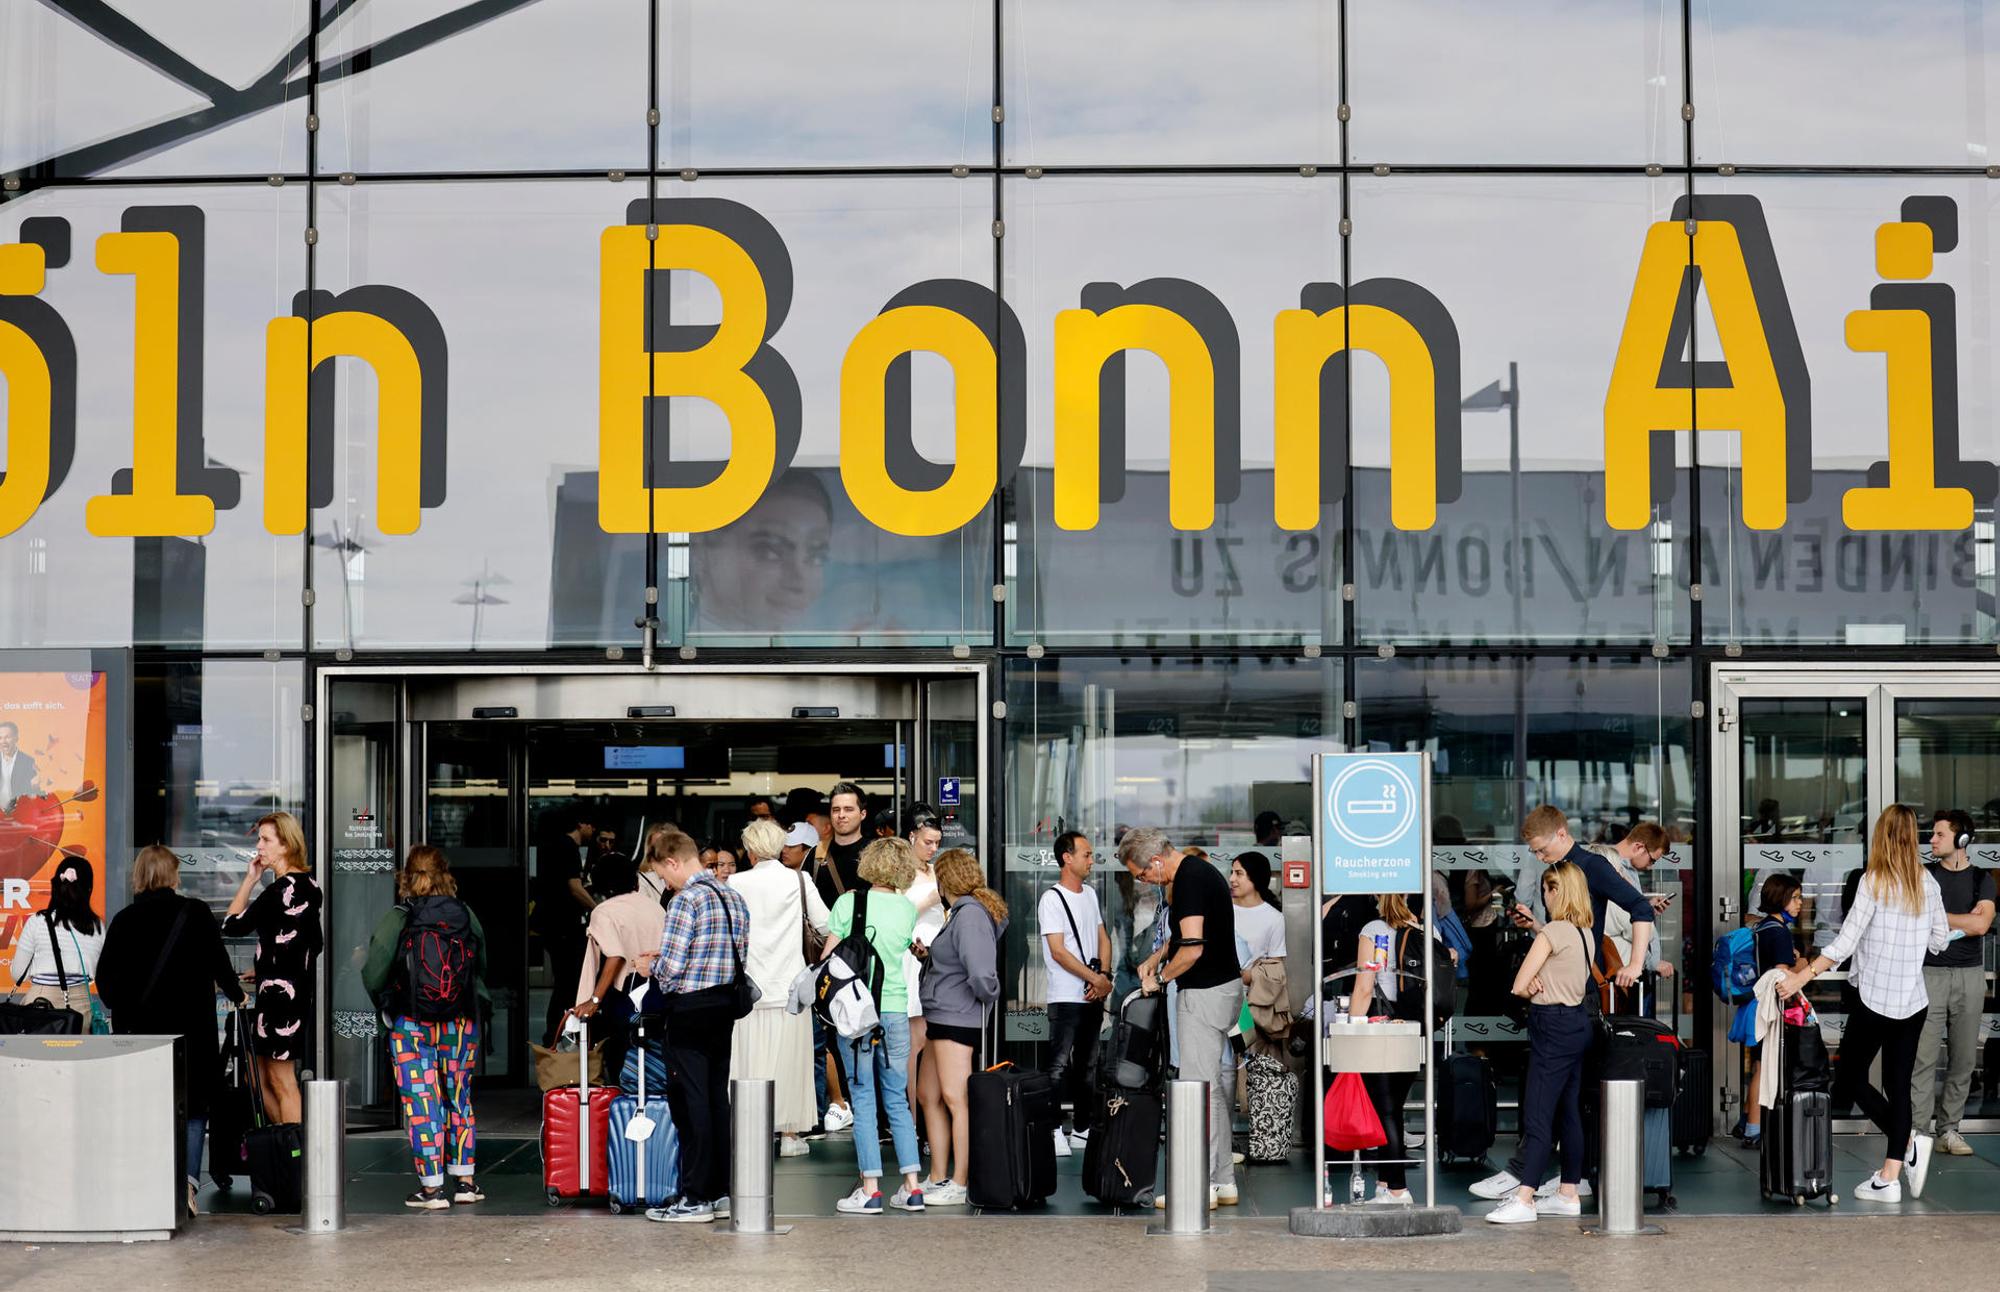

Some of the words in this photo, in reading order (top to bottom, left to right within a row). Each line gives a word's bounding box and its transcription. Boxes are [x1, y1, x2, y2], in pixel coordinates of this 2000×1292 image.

[599, 223, 1437, 537] Bonn
[1603, 220, 1975, 531] Ai
[1335, 856, 1411, 869] Raucherzone
[1348, 870, 1380, 879] Smoking
